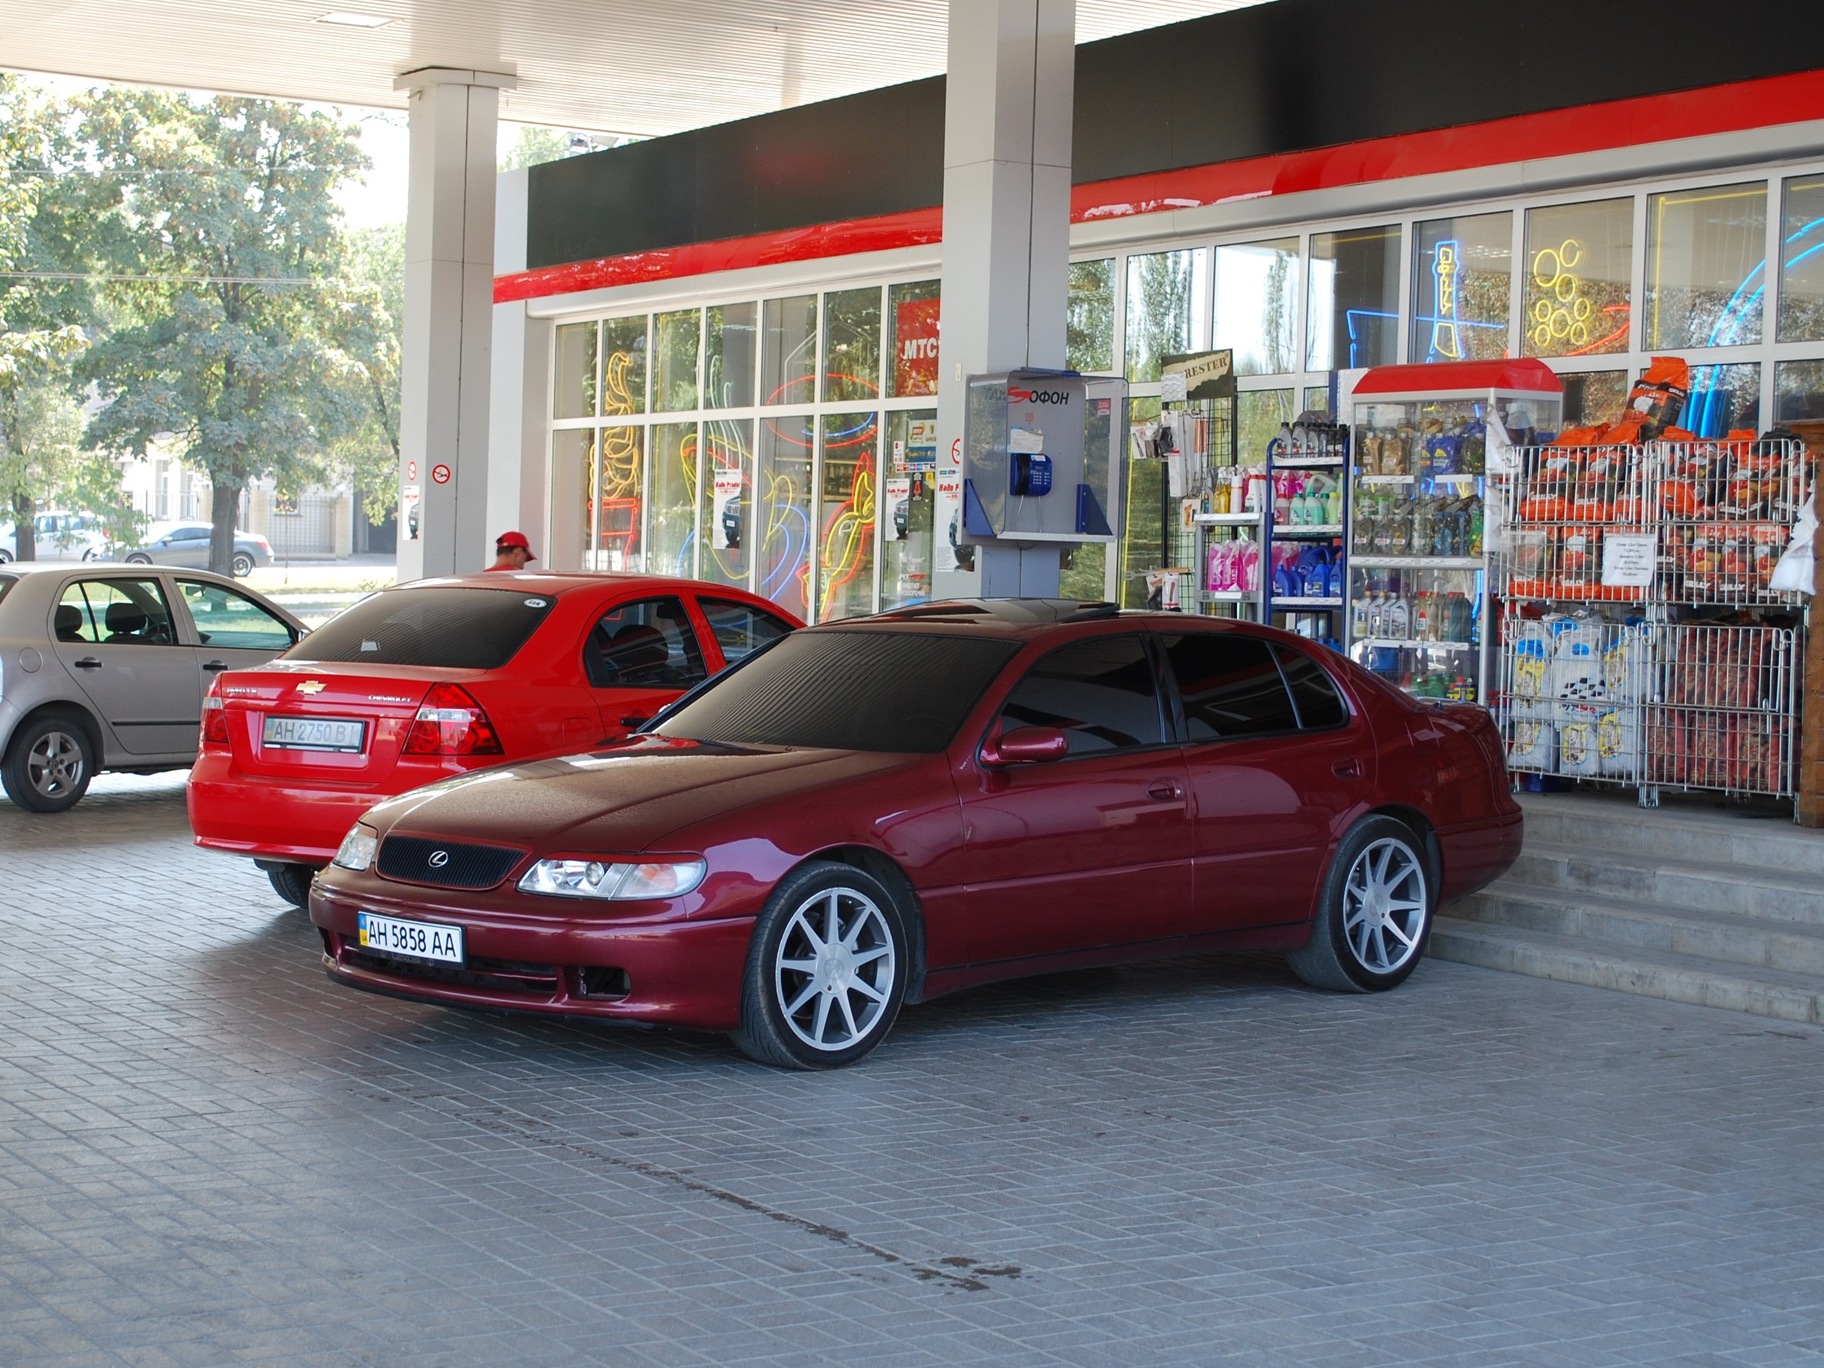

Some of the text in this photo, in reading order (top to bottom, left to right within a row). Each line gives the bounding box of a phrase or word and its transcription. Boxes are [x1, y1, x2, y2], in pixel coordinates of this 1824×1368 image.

[1184, 357, 1228, 379] RESTER
[273, 720, 296, 740] AH
[299, 722, 332, 743] 2750
[368, 920, 456, 957] AH 5858 AA
